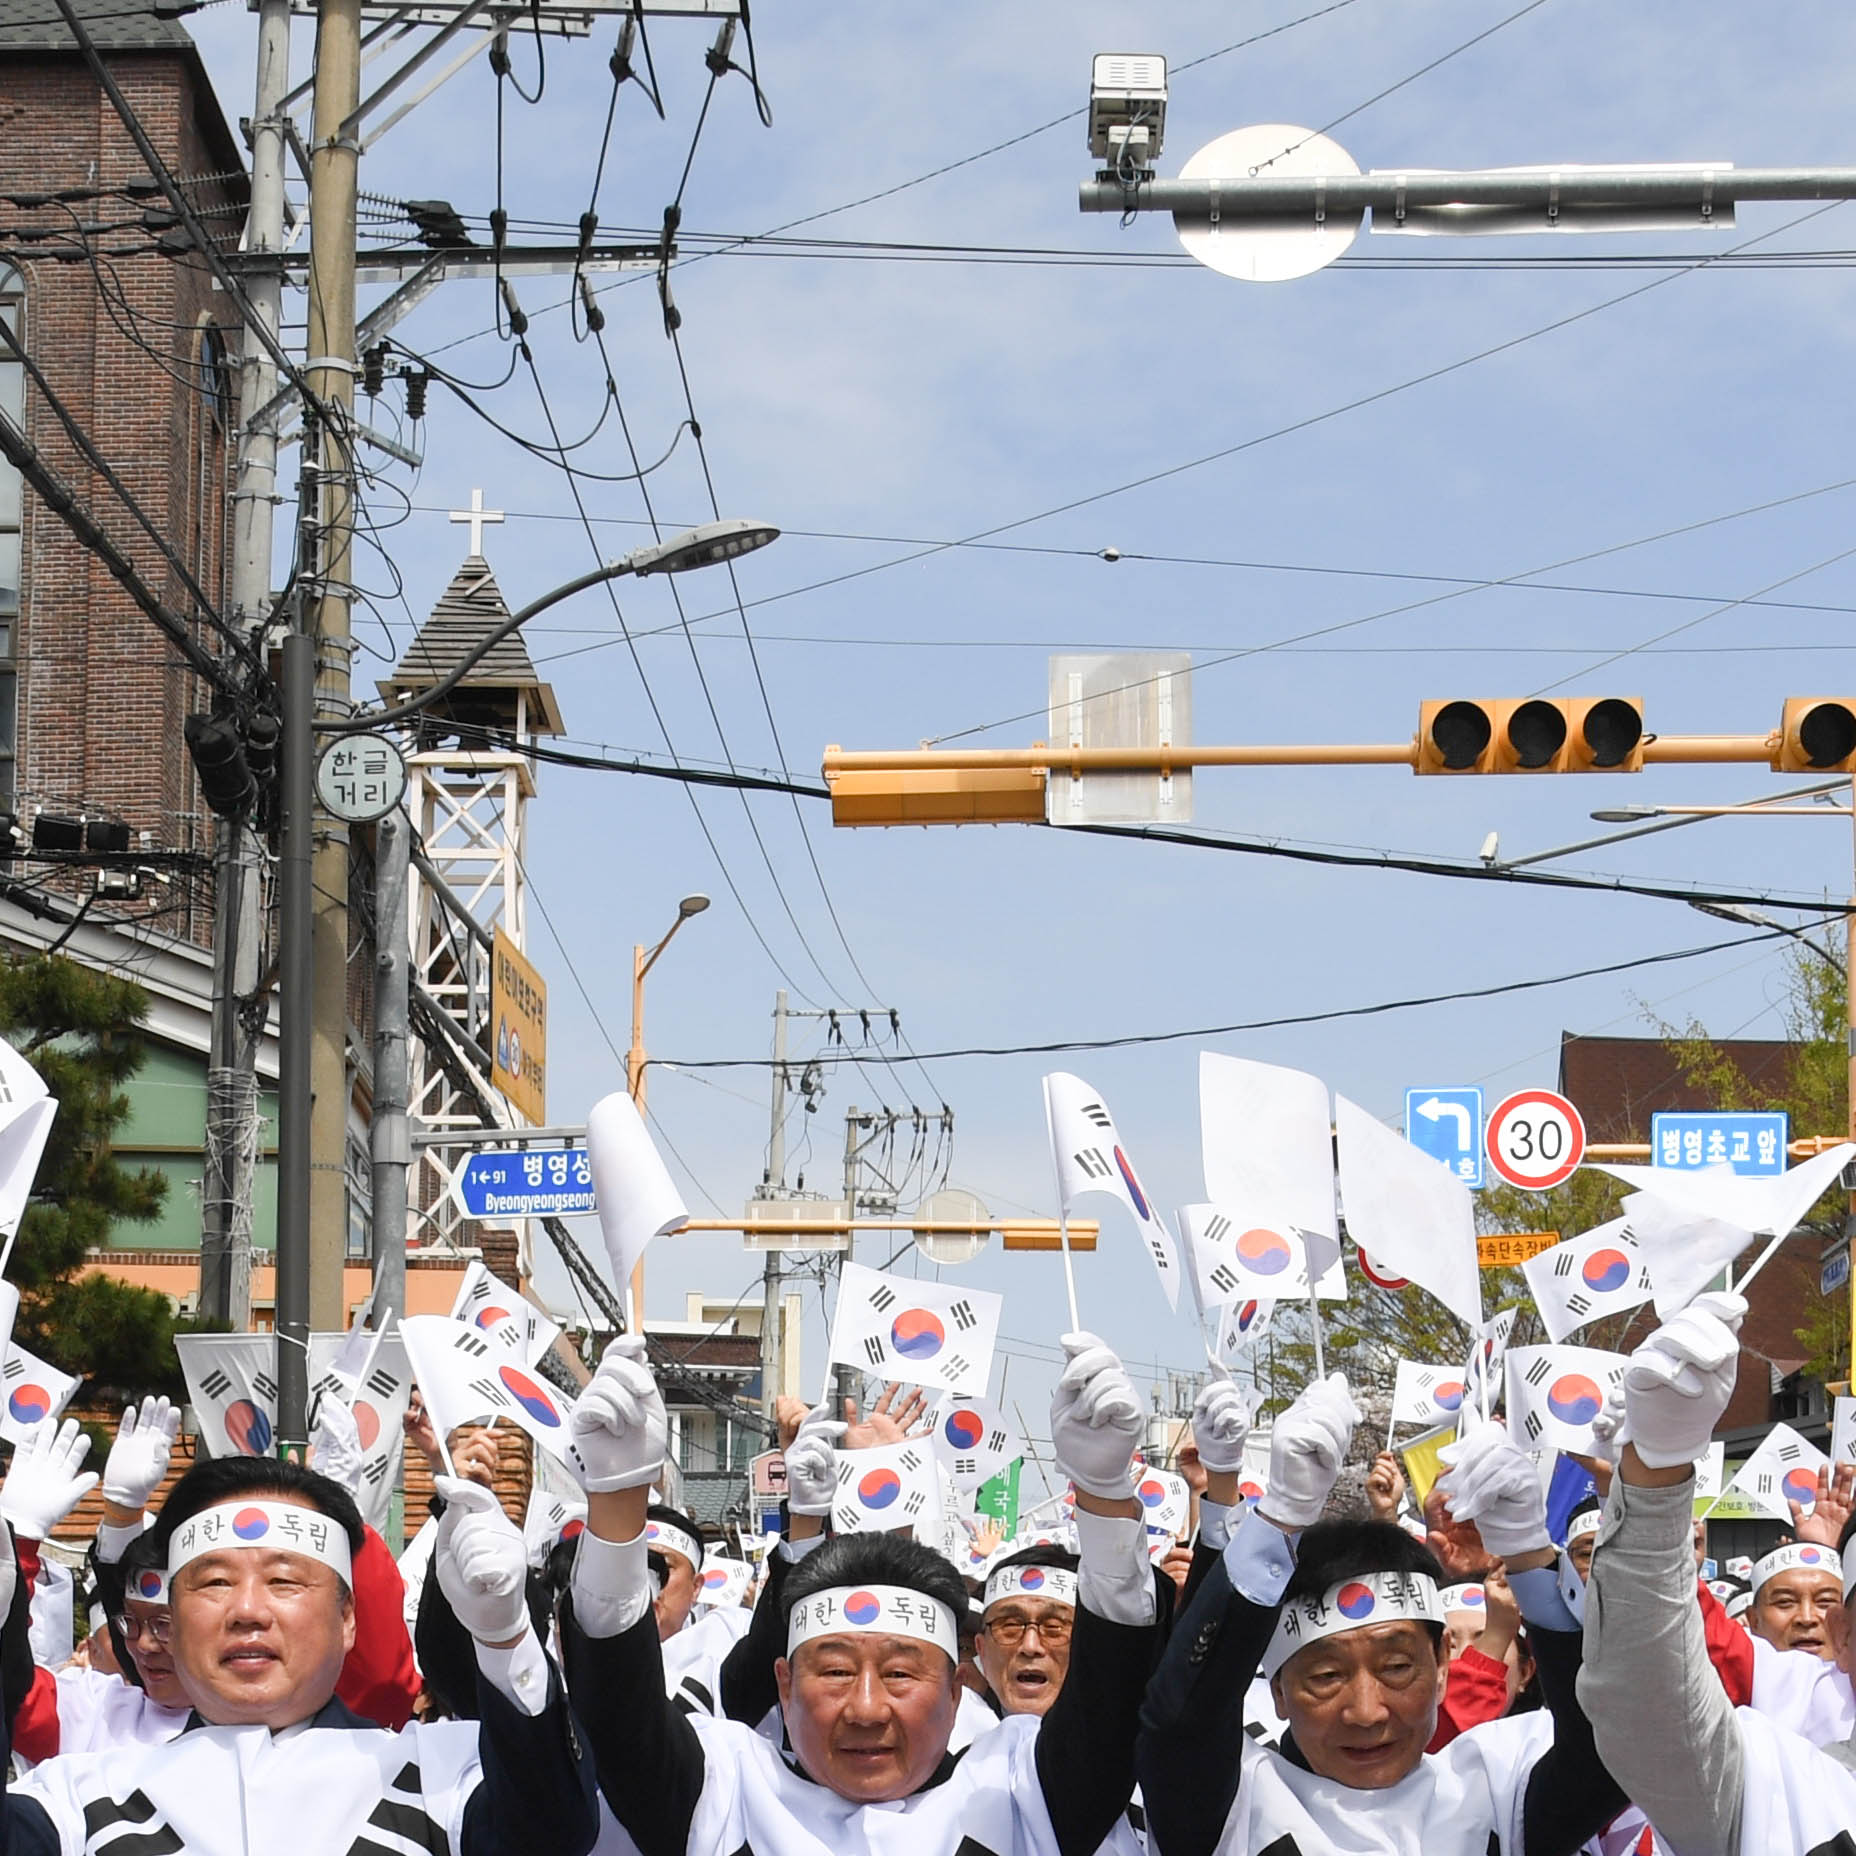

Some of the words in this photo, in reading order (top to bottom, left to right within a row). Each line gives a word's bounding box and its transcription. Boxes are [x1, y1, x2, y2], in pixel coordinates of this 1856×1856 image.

[331, 750, 389, 777] 한글
[333, 780, 387, 806] 거리
[1509, 1120, 1564, 1161] 30
[181, 1514, 225, 1550] 대한
[277, 1513, 328, 1553] 독립
[1765, 1549, 1795, 1572] 대한
[794, 1596, 837, 1632] 대한
[887, 1596, 937, 1633] 독립
[1283, 1601, 1332, 1638] 대한
[1381, 1579, 1427, 1612] 독립
